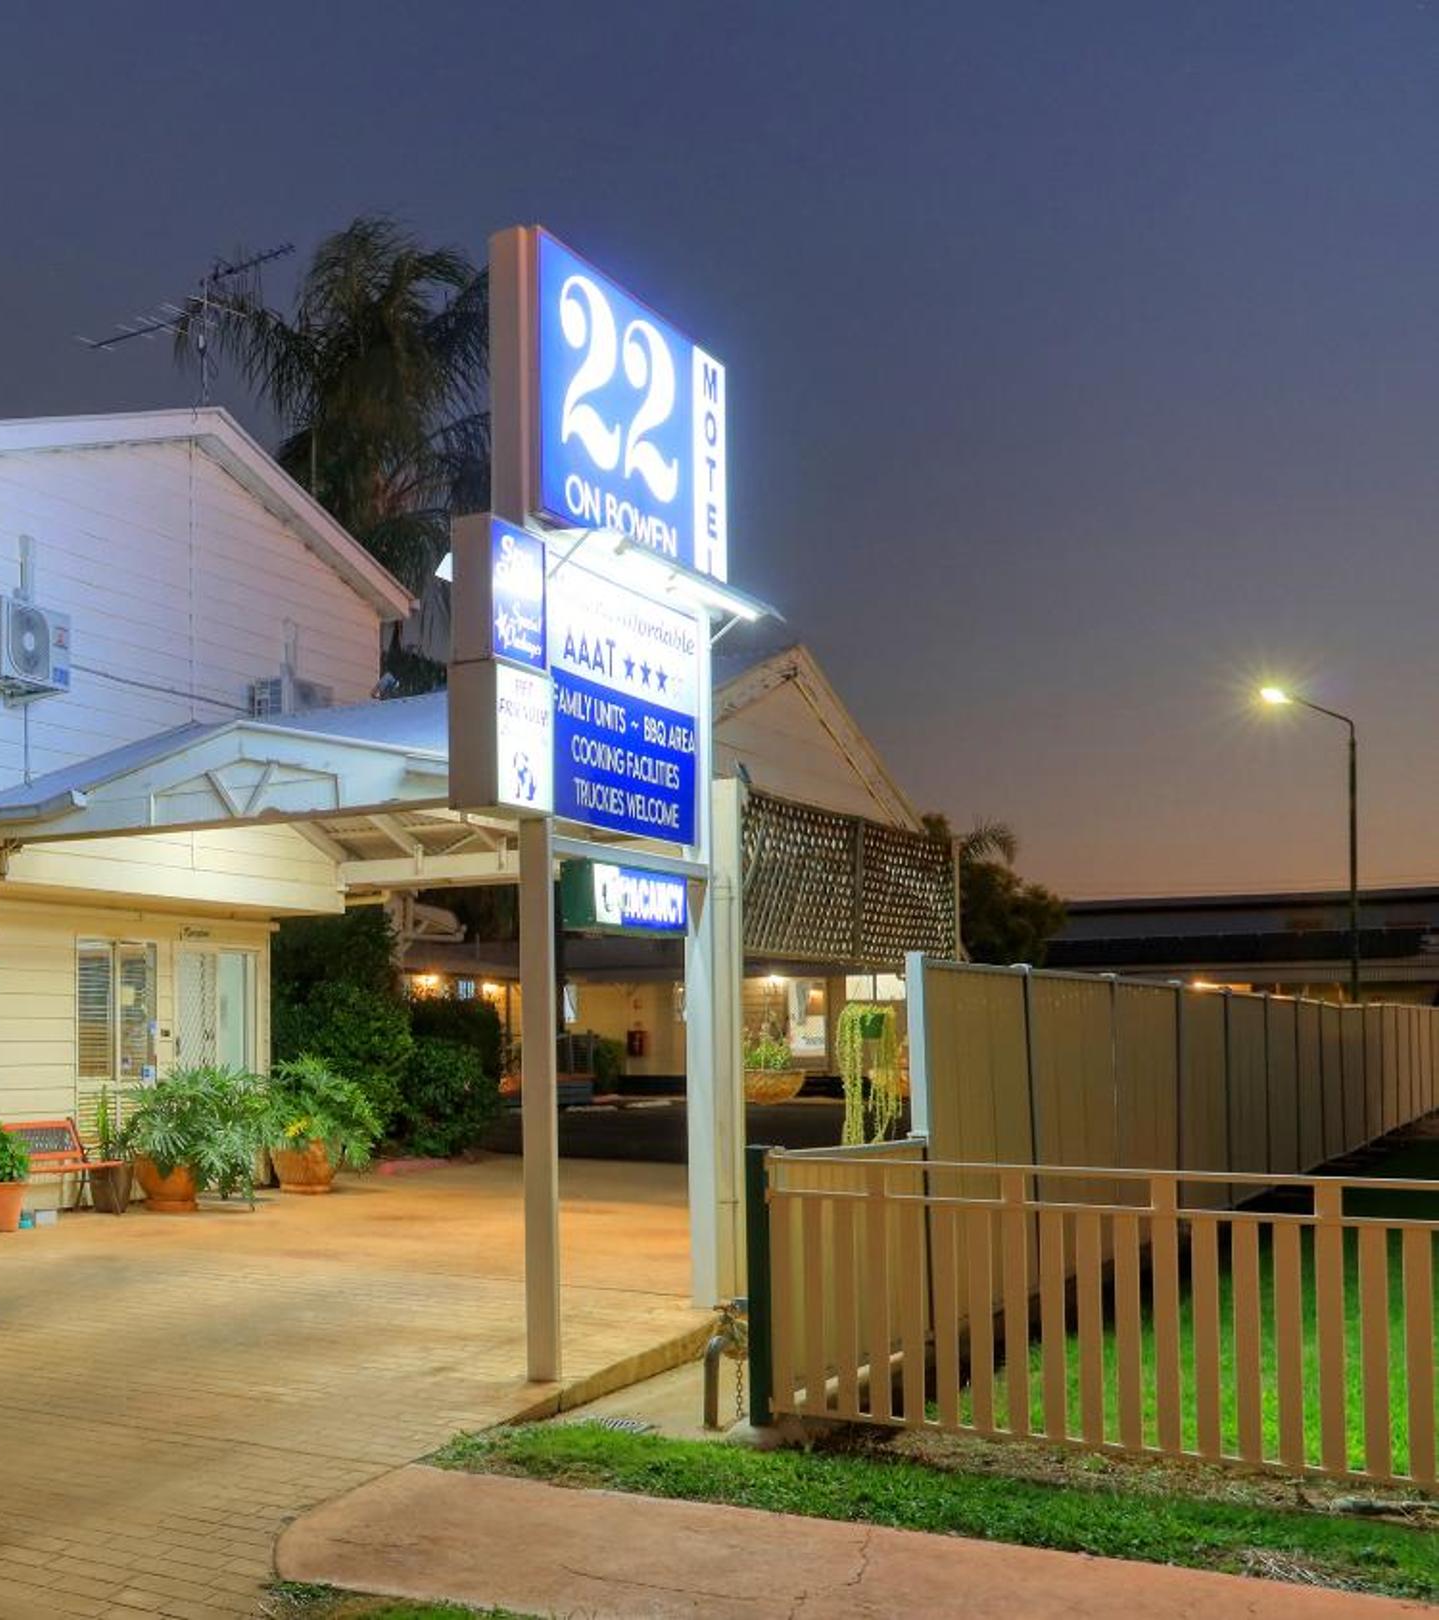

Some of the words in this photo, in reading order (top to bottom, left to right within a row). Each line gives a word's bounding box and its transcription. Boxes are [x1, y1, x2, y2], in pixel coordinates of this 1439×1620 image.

[559, 275, 678, 503] 22
[565, 474, 601, 526] ON
[605, 492, 678, 557] BOWEN
[563, 625, 616, 678] AAAT
[594, 698, 626, 734] UNITS
[644, 715, 666, 747] BBQ
[669, 725, 695, 753] AREA
[571, 734, 626, 775] COOKING
[626, 751, 680, 790] FACILITIES
[574, 777, 625, 816] TRUCKIES
[626, 792, 680, 829] WELCOME
